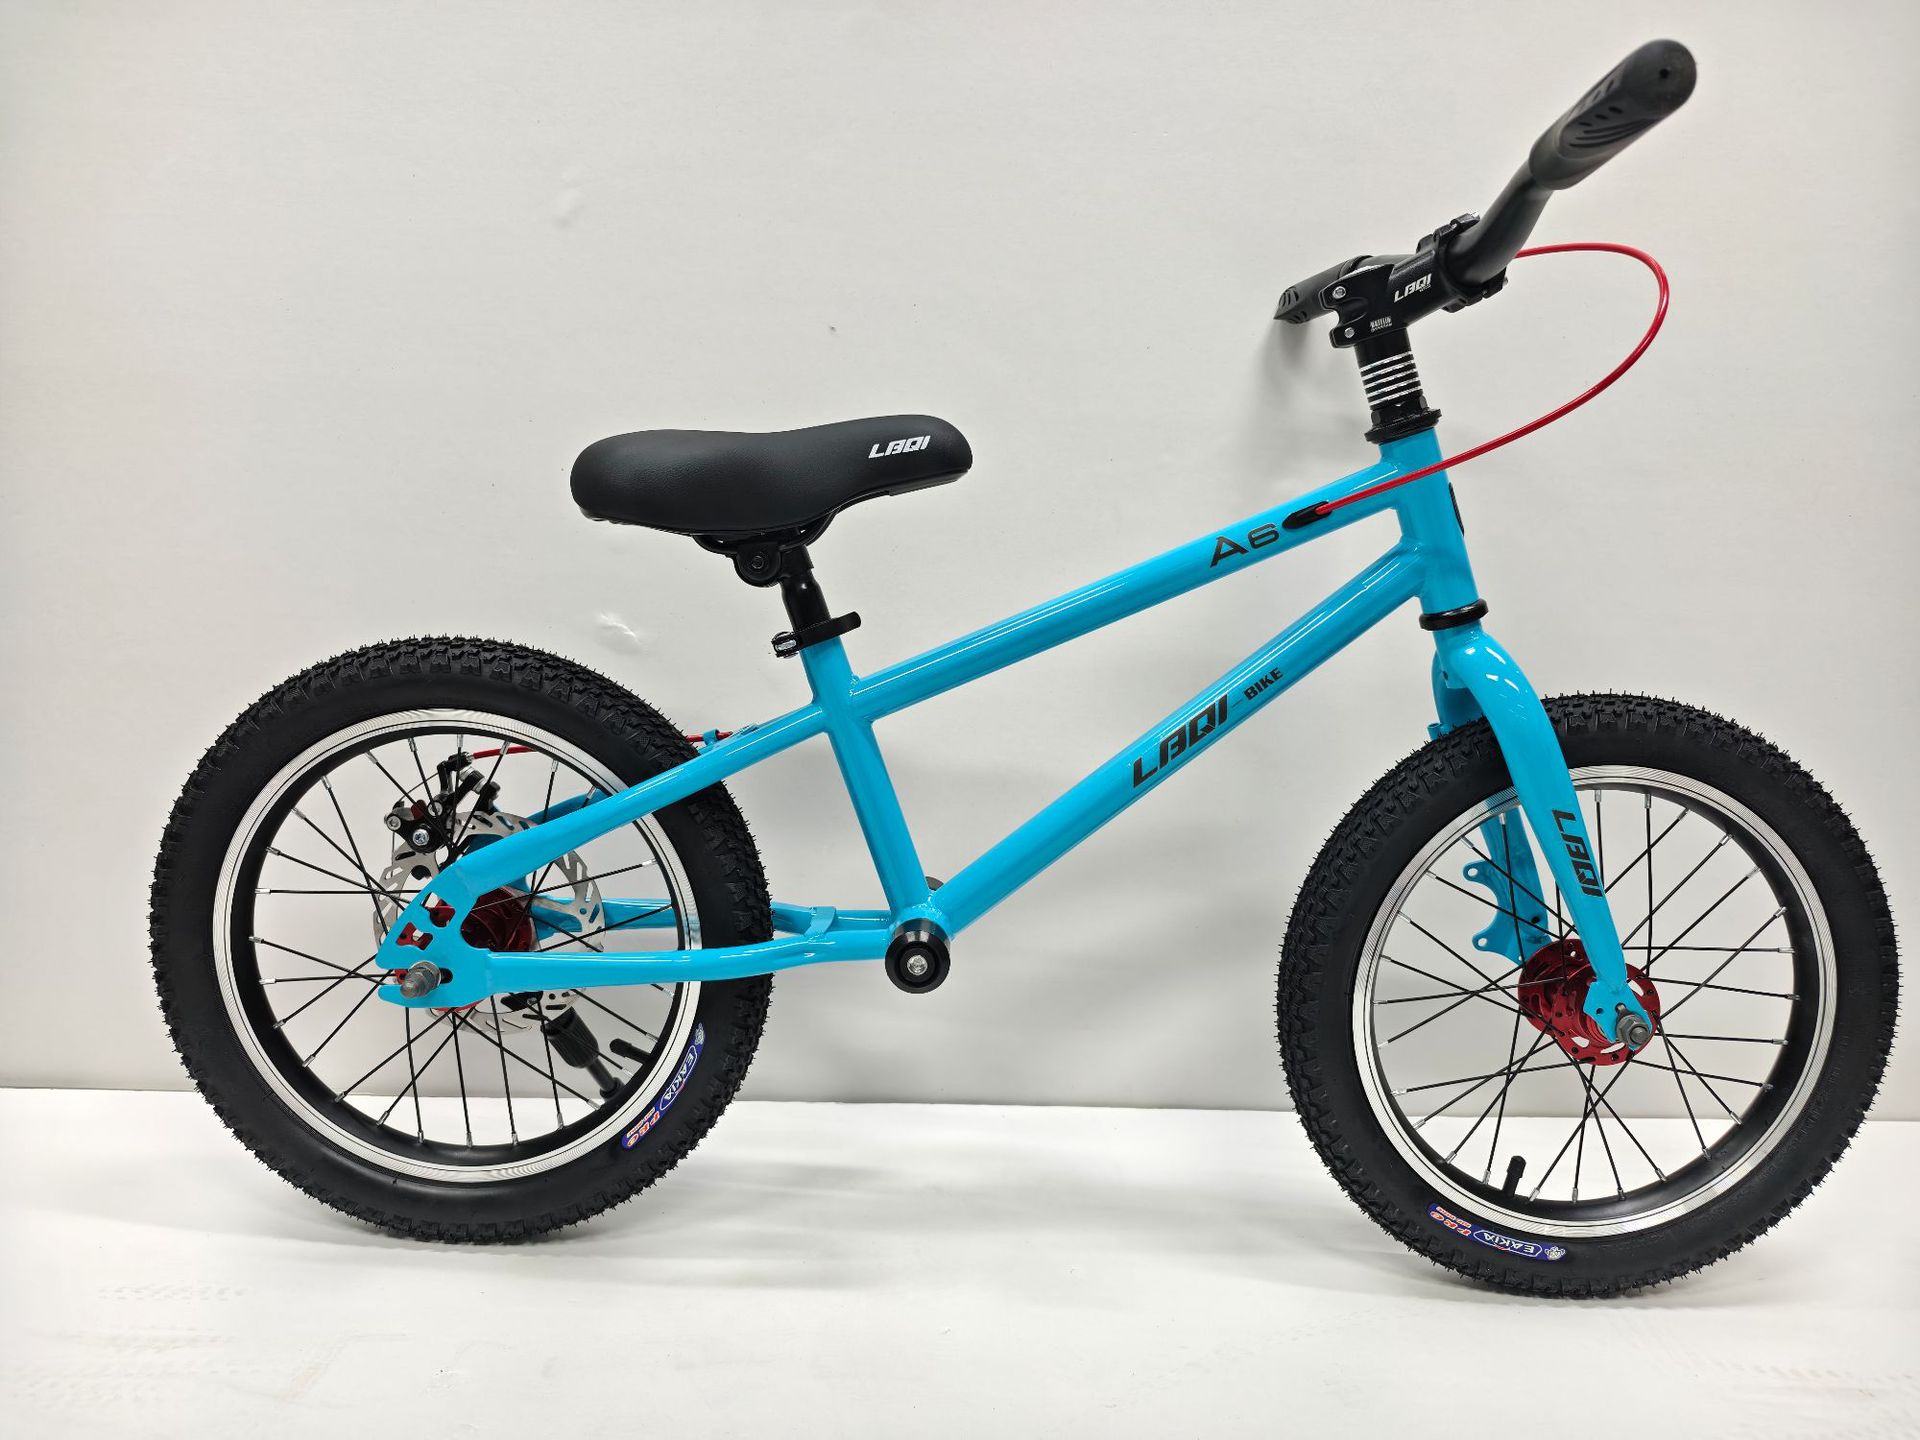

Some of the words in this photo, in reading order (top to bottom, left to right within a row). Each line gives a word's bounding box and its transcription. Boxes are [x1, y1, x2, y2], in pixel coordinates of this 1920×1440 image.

[1210, 523, 1279, 568] A6
[1243, 667, 1284, 701] BIKE
[1483, 1231, 1535, 1254] EAKIA
